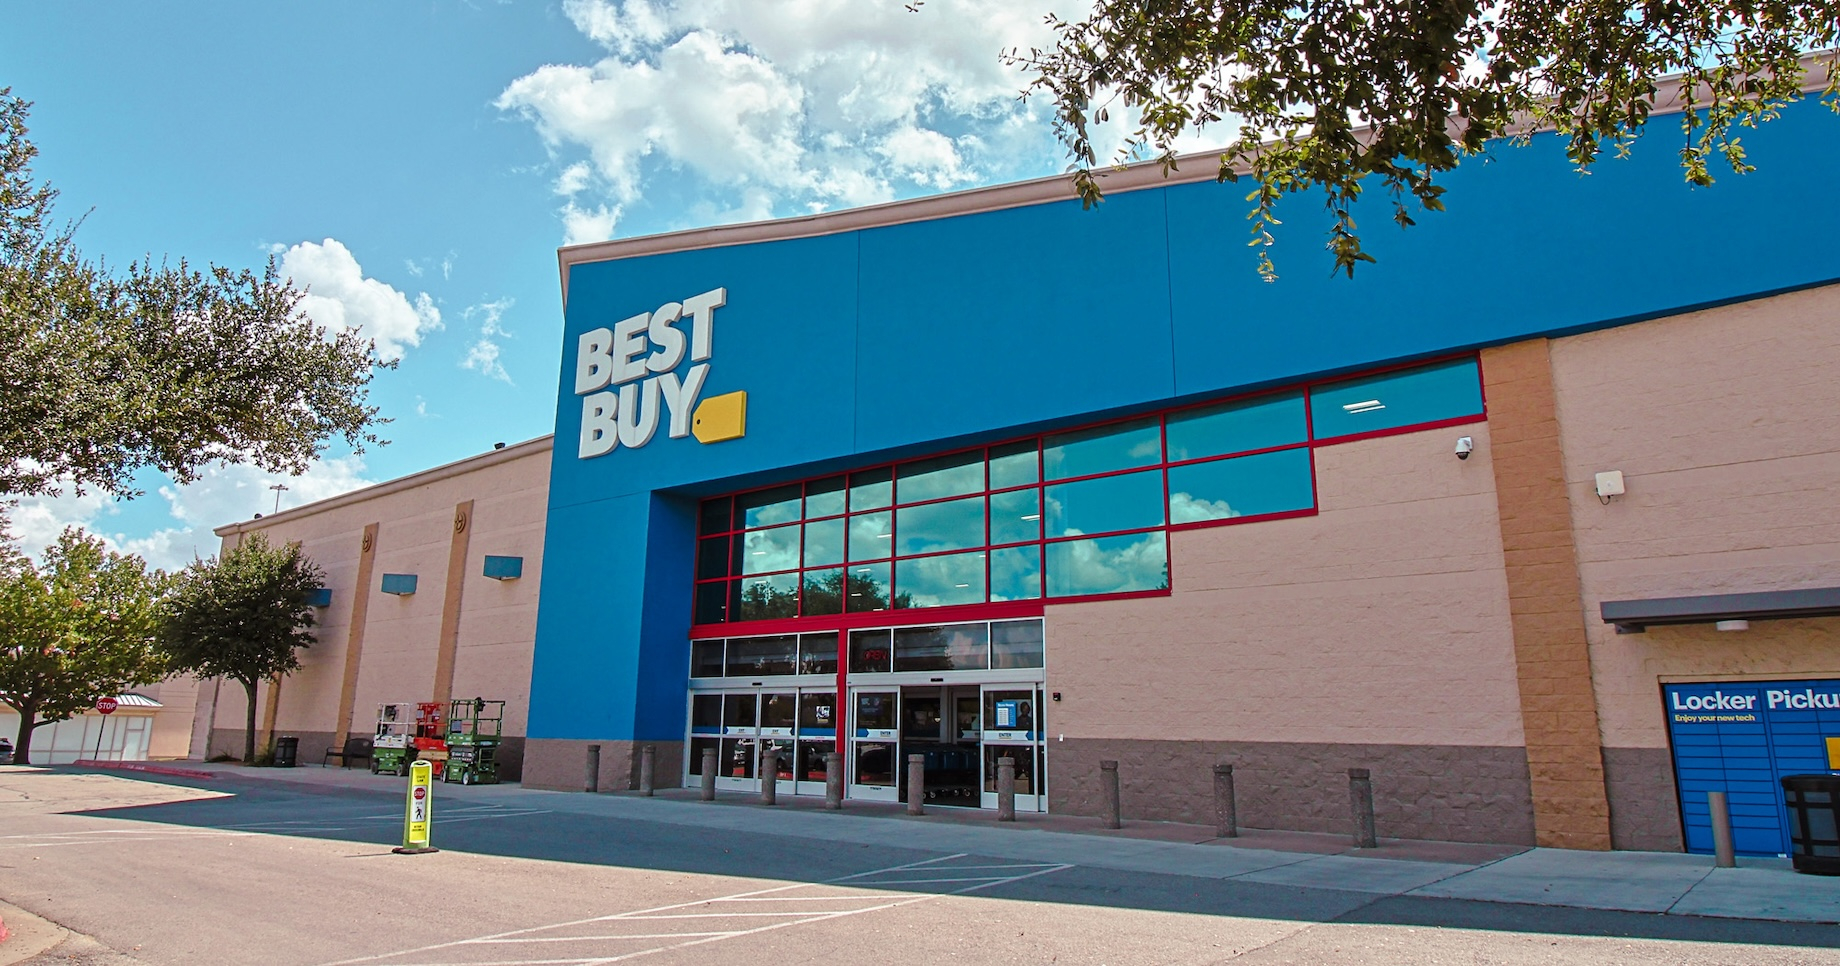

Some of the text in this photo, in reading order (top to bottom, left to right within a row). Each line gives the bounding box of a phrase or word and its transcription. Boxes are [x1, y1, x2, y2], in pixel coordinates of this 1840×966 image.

[575, 287, 727, 395] BEST
[578, 363, 711, 460] BUY
[97, 702, 117, 710] STOP
[1672, 689, 1840, 710] Locker Picku
[1674, 714, 1697, 722] Enjoy
